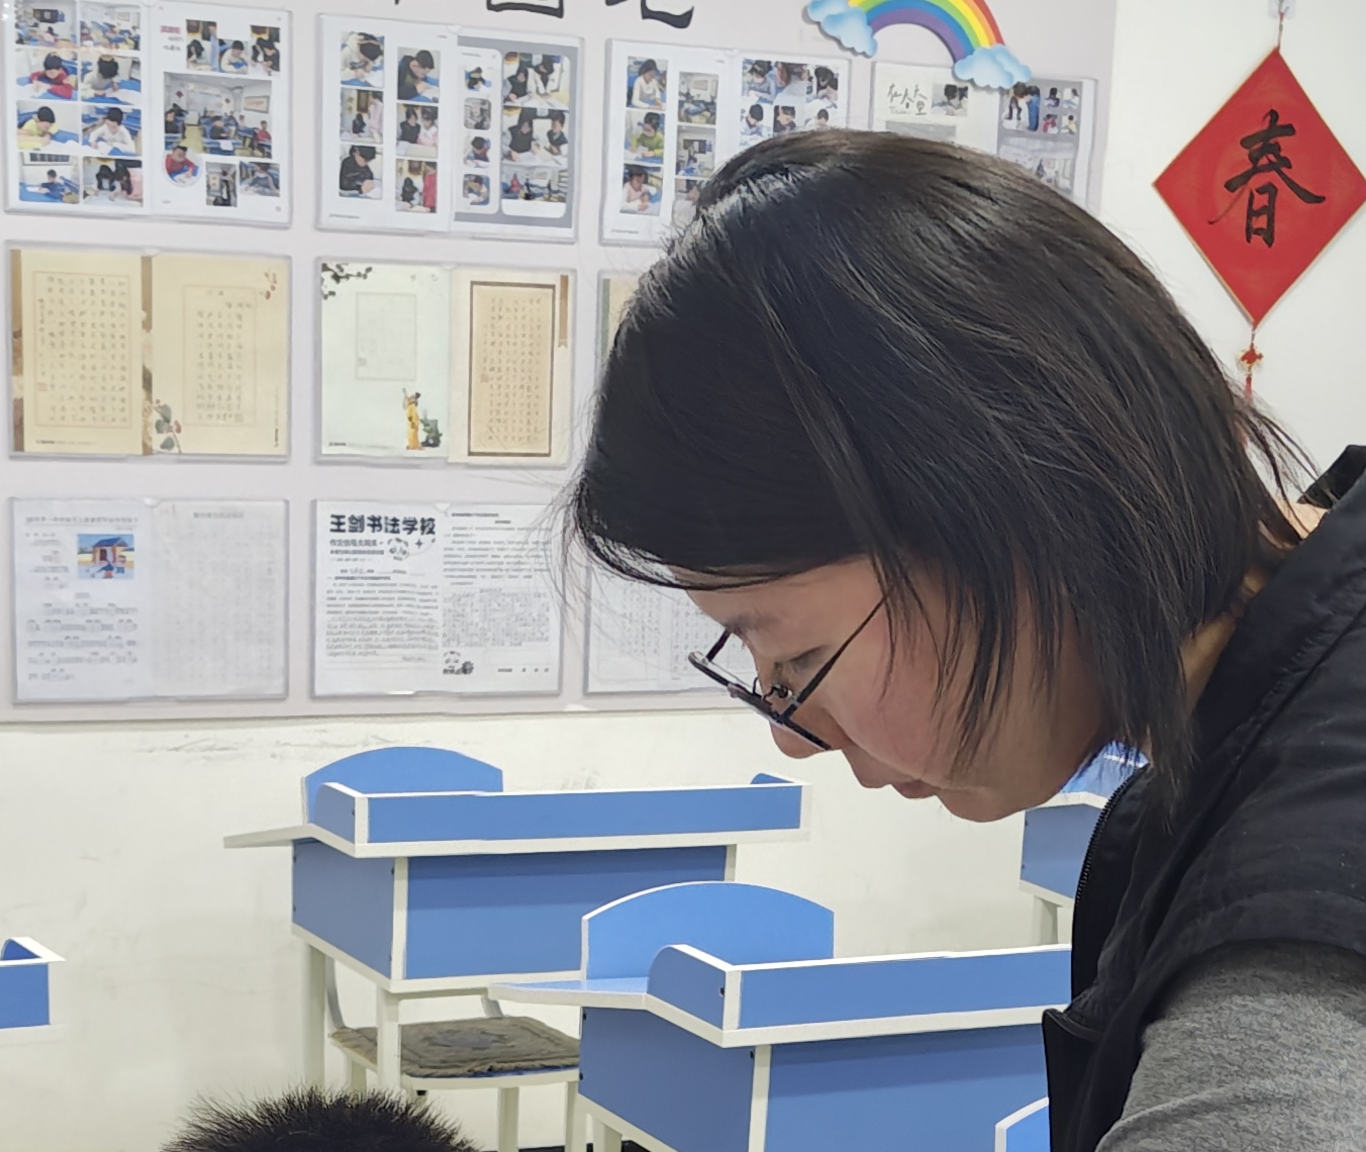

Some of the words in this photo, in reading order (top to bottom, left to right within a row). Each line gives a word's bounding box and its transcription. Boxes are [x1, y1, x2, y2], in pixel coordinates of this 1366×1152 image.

[1208, 108, 1326, 248] 春
[330, 514, 436, 535] 王剑书法学校
